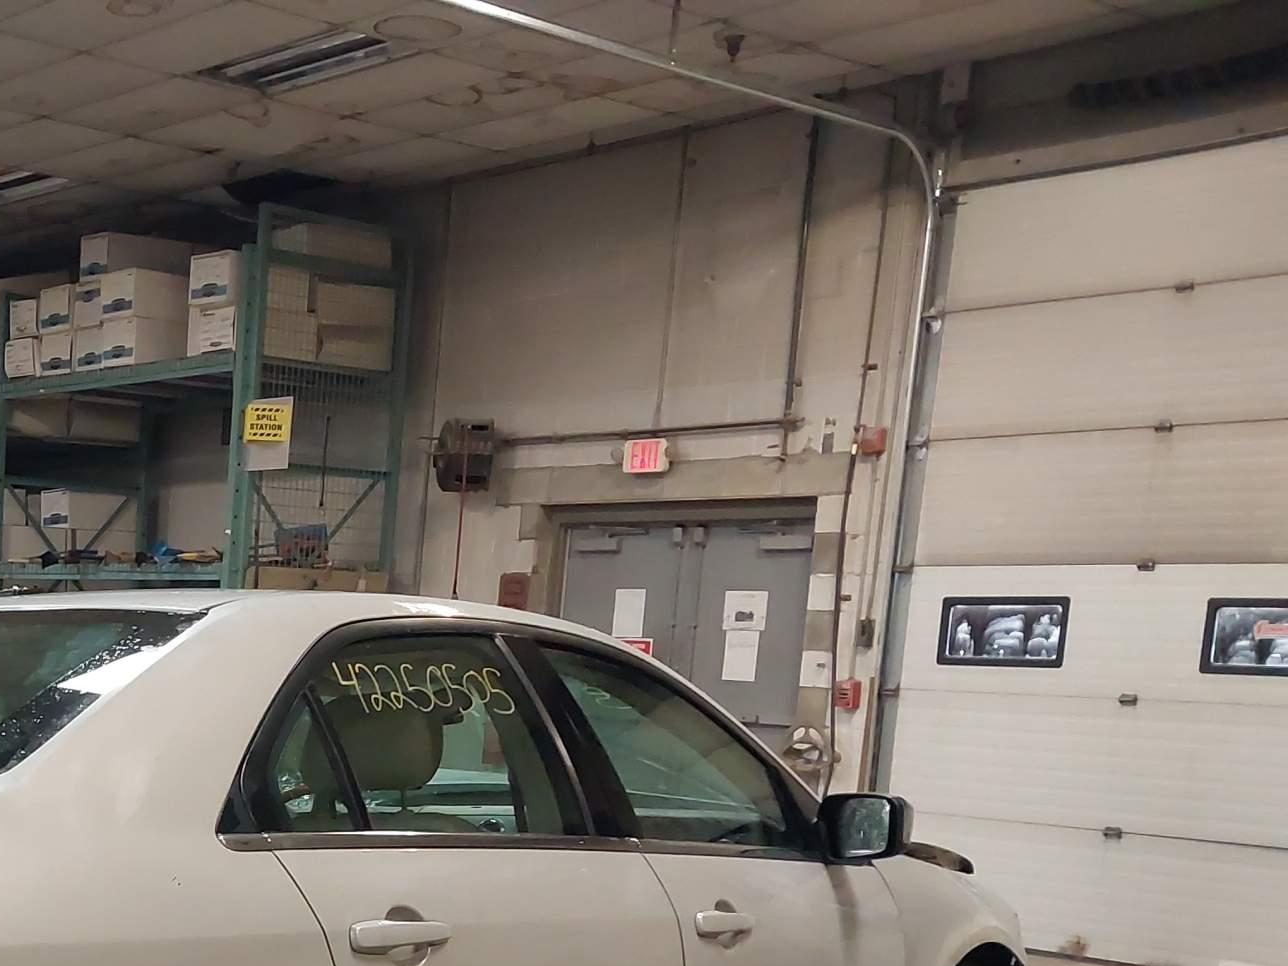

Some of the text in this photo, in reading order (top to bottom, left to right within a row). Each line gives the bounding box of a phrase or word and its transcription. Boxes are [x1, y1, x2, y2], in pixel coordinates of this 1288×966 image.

[249, 423, 283, 431] STATION
[255, 414, 278, 422] SPILL
[631, 441, 660, 470] EXIT
[332, 661, 515, 714] 42250505
